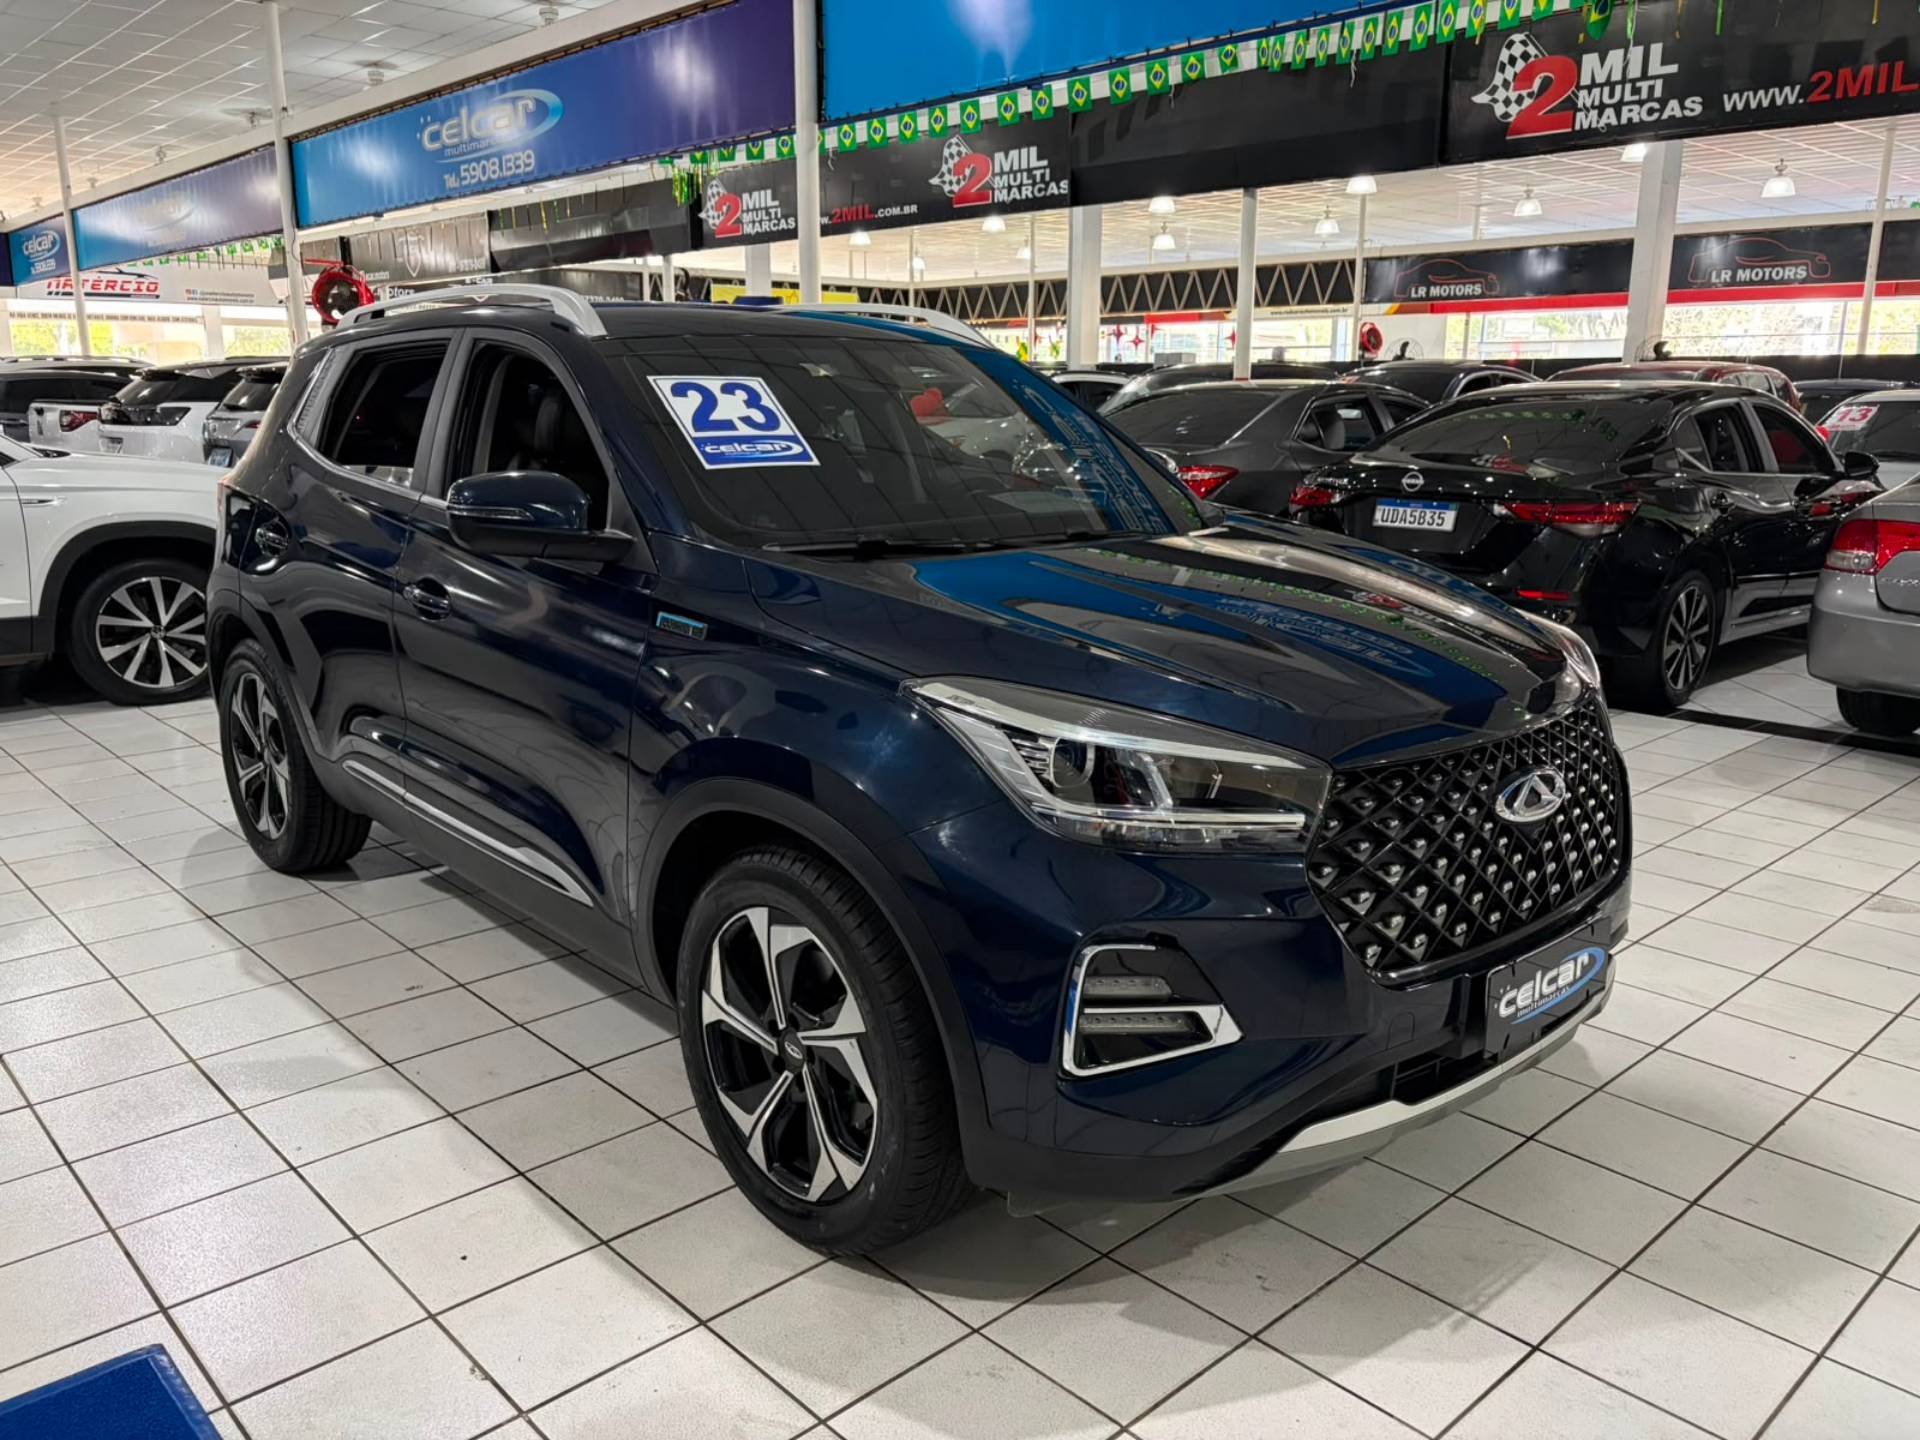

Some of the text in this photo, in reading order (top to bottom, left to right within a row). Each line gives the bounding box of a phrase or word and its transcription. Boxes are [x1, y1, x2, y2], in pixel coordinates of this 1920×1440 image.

[1505, 42, 1679, 140] 2 MIL
[1577, 78, 1664, 108] MULTI
[1574, 96, 1704, 131] MARCAS
[952, 146, 1049, 208] 2 MIL
[994, 168, 1050, 189] MULTI
[994, 180, 1069, 203] MARCAS
[714, 189, 779, 238] 2 MIL
[742, 207, 782, 224] MULTI
[742, 217, 796, 235] MARCAS
[1710, 265, 1808, 283] LR MOTORS
[1410, 283, 1482, 298] LR MOTORS
[670, 381, 781, 432] 23
[704, 442, 788, 454] celcar
[1379, 507, 1447, 527] UDA5B35
[1498, 952, 1590, 1018] celcar
